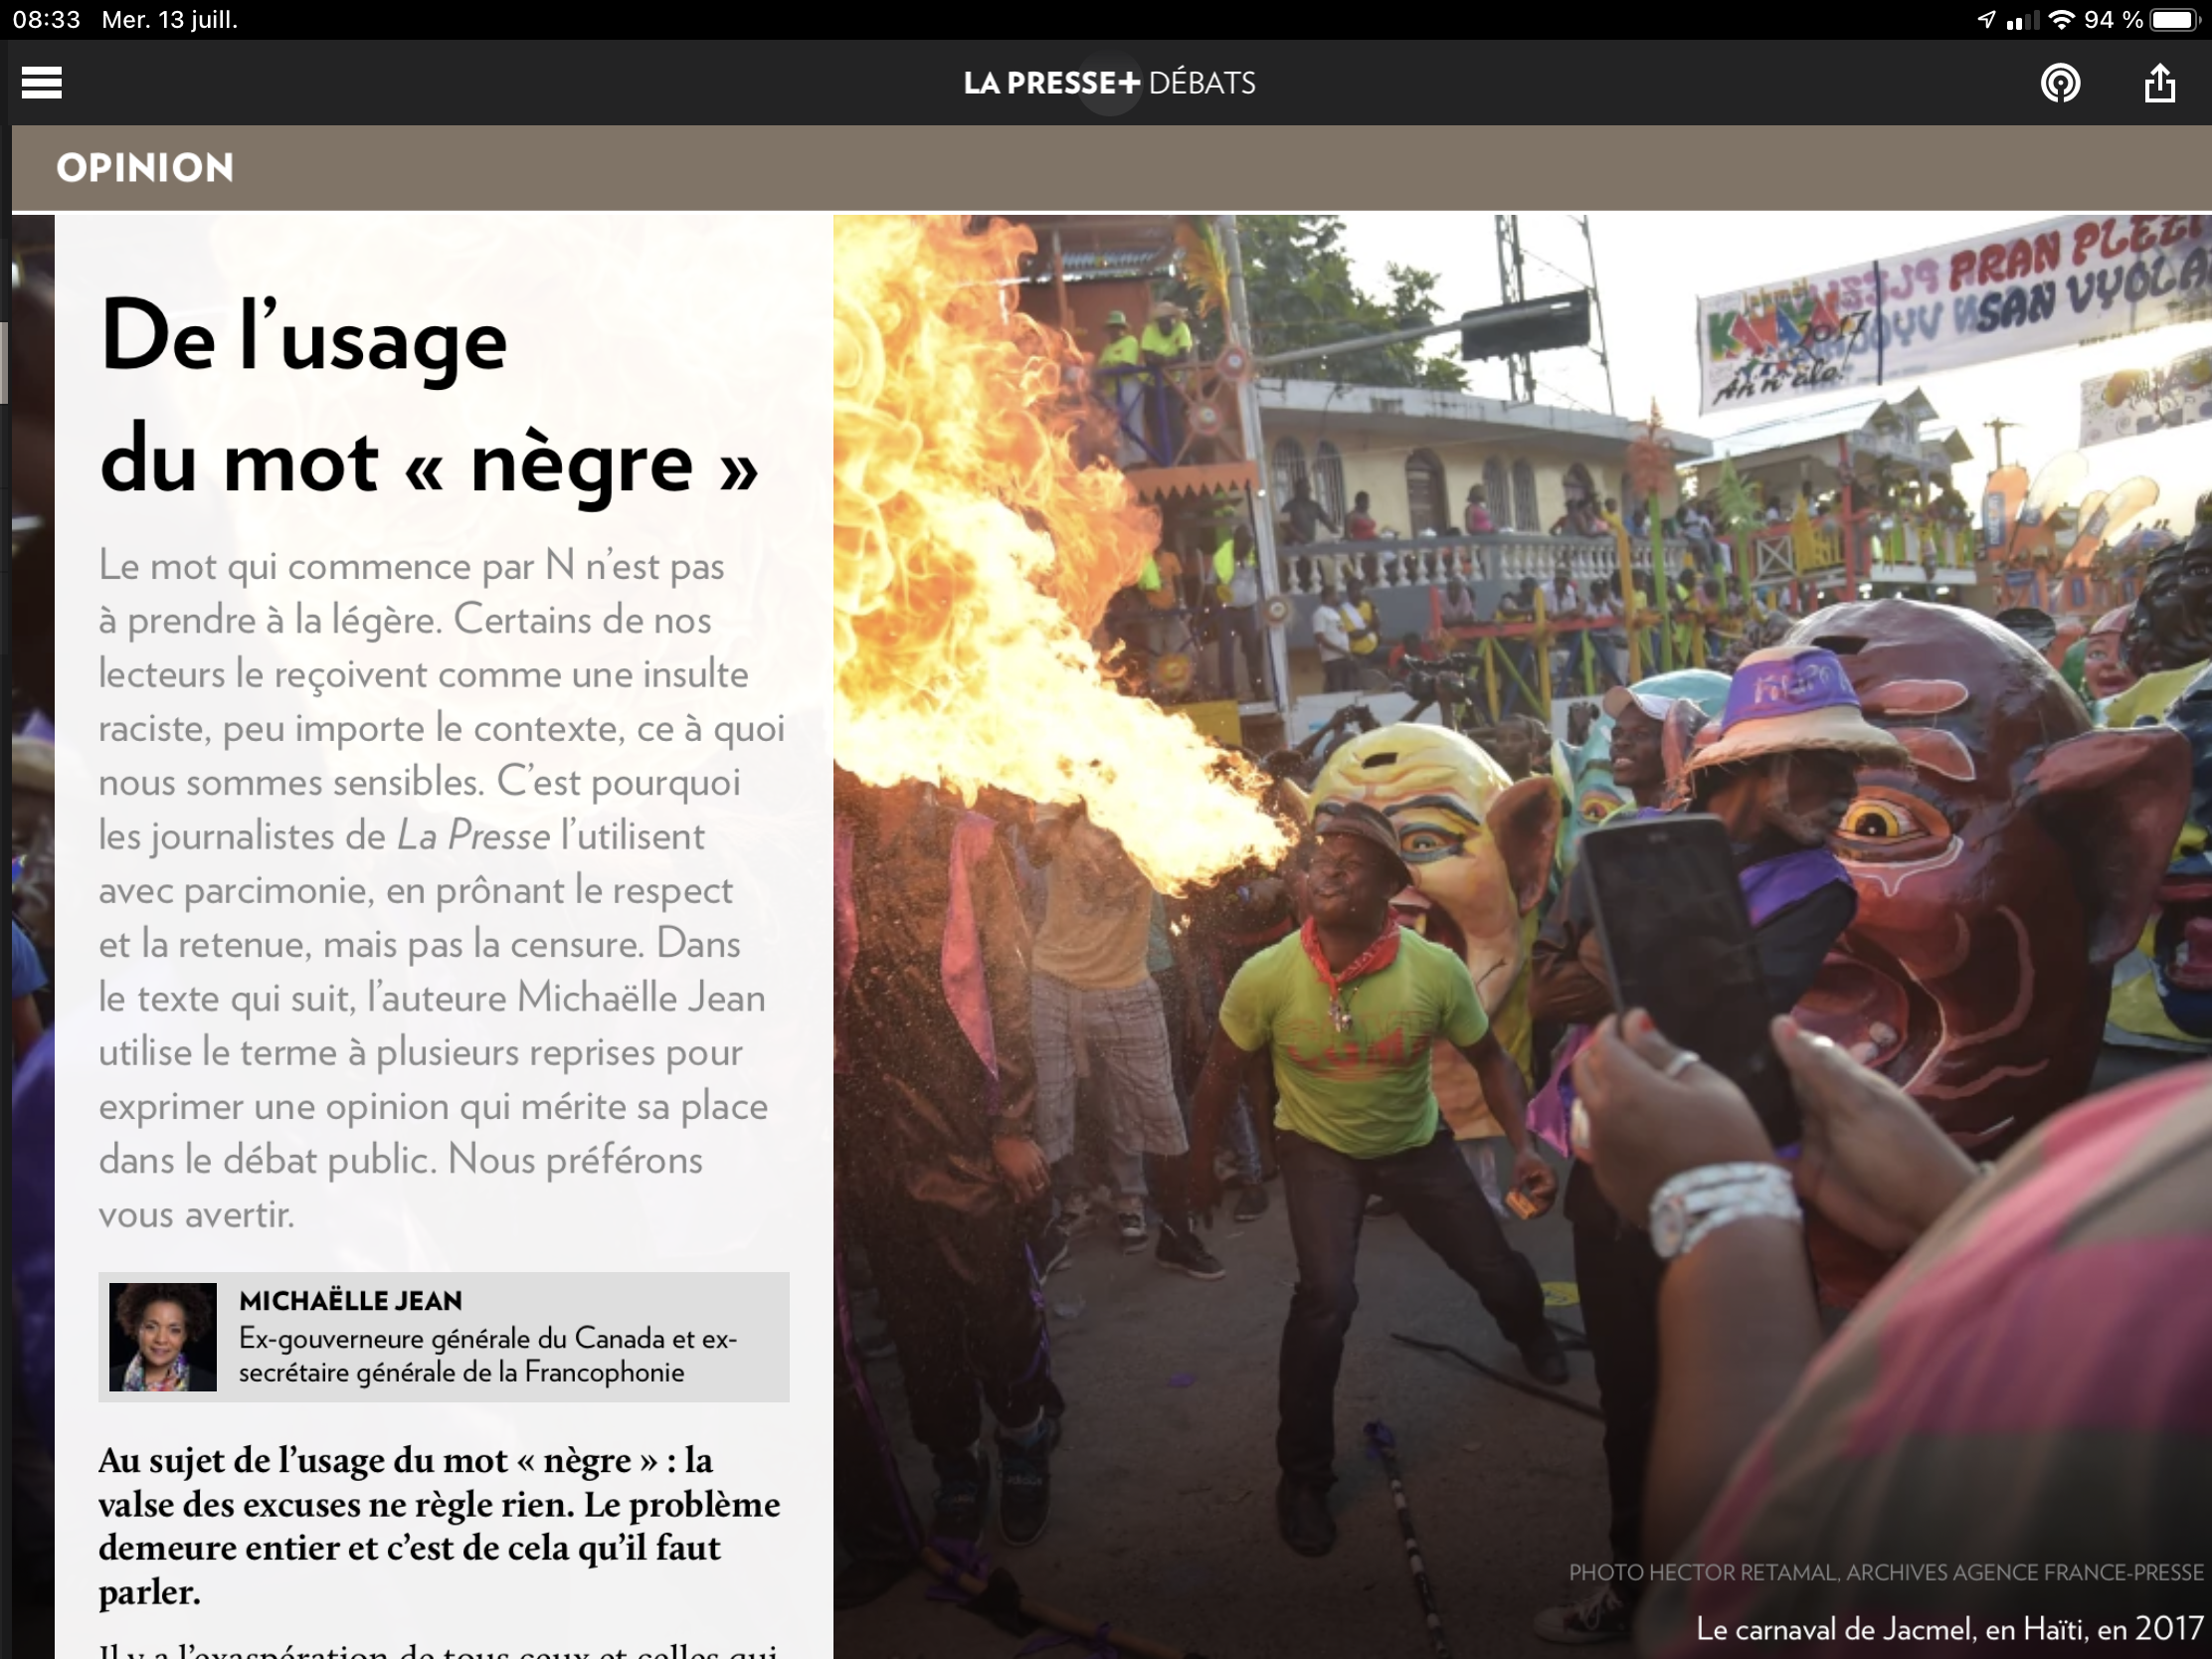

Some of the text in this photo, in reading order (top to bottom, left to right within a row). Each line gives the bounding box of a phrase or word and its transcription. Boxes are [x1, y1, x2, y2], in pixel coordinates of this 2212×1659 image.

[13, 9, 238, 33] 08:33 Mer. 13 juill.
[2085, 10, 2115, 29] 94
[965, 71, 1002, 94] LA
[1150, 64, 1256, 94] DÉBATS
[57, 151, 233, 183] OPINION
[1949, 230, 2061, 291] PRAN
[1976, 280, 2057, 332] SAN
[2066, 246, 2212, 313] VYOLA
[105, 295, 507, 391] De l’usage
[1797, 309, 1873, 371] 2017
[101, 418, 195, 492] du
[226, 435, 379, 492] mot
[473, 425, 692, 513] nègre
[100, 546, 725, 590] Le mot qui commence par N n’est pas
[98, 600, 711, 644] à prendre à la légère. Certains de nos
[99, 654, 749, 698] lecteurs le reçoivent comme une insulte
[99, 708, 785, 752] raciste, peu importe le contexte, ce à quoi
[99, 762, 740, 806] nous sommes sensibles. C’est pourquoi
[99, 816, 706, 859] les journalistes de La Presse l’utilisent
[98, 870, 734, 913] avec parcimonie, en prônant le respect
[99, 924, 741, 968] et la retenue, mais pas la censure. Dans
[99, 978, 765, 1021] le texte qui suit, l’auteure Michaëlle Jean
[97, 1199, 294, 1228] vous avertir.
[240, 1284, 461, 1311] MICHAËLLE JEAN
[240, 1324, 737, 1356] Ex-gouverneure générale du Canada et ex-
[239, 1358, 685, 1388] secrétaire générale de la Francophonie
[97, 1446, 141, 1474] Au
[149, 1445, 226, 1482] sujet
[234, 1444, 271, 1474] de
[278, 1444, 386, 1482] l’usage
[393, 1444, 436, 1474] du
[443, 1450, 509, 1474] mot
[543, 1445, 632, 1482] nègre
[684, 1444, 714, 1474] la
[97, 1488, 781, 1527] valse des excuses ne règle rien. Le problème
[98, 1532, 722, 1569] demeure entier et c’est de cela qu’il faut
[98, 1575, 201, 1614] parler.
